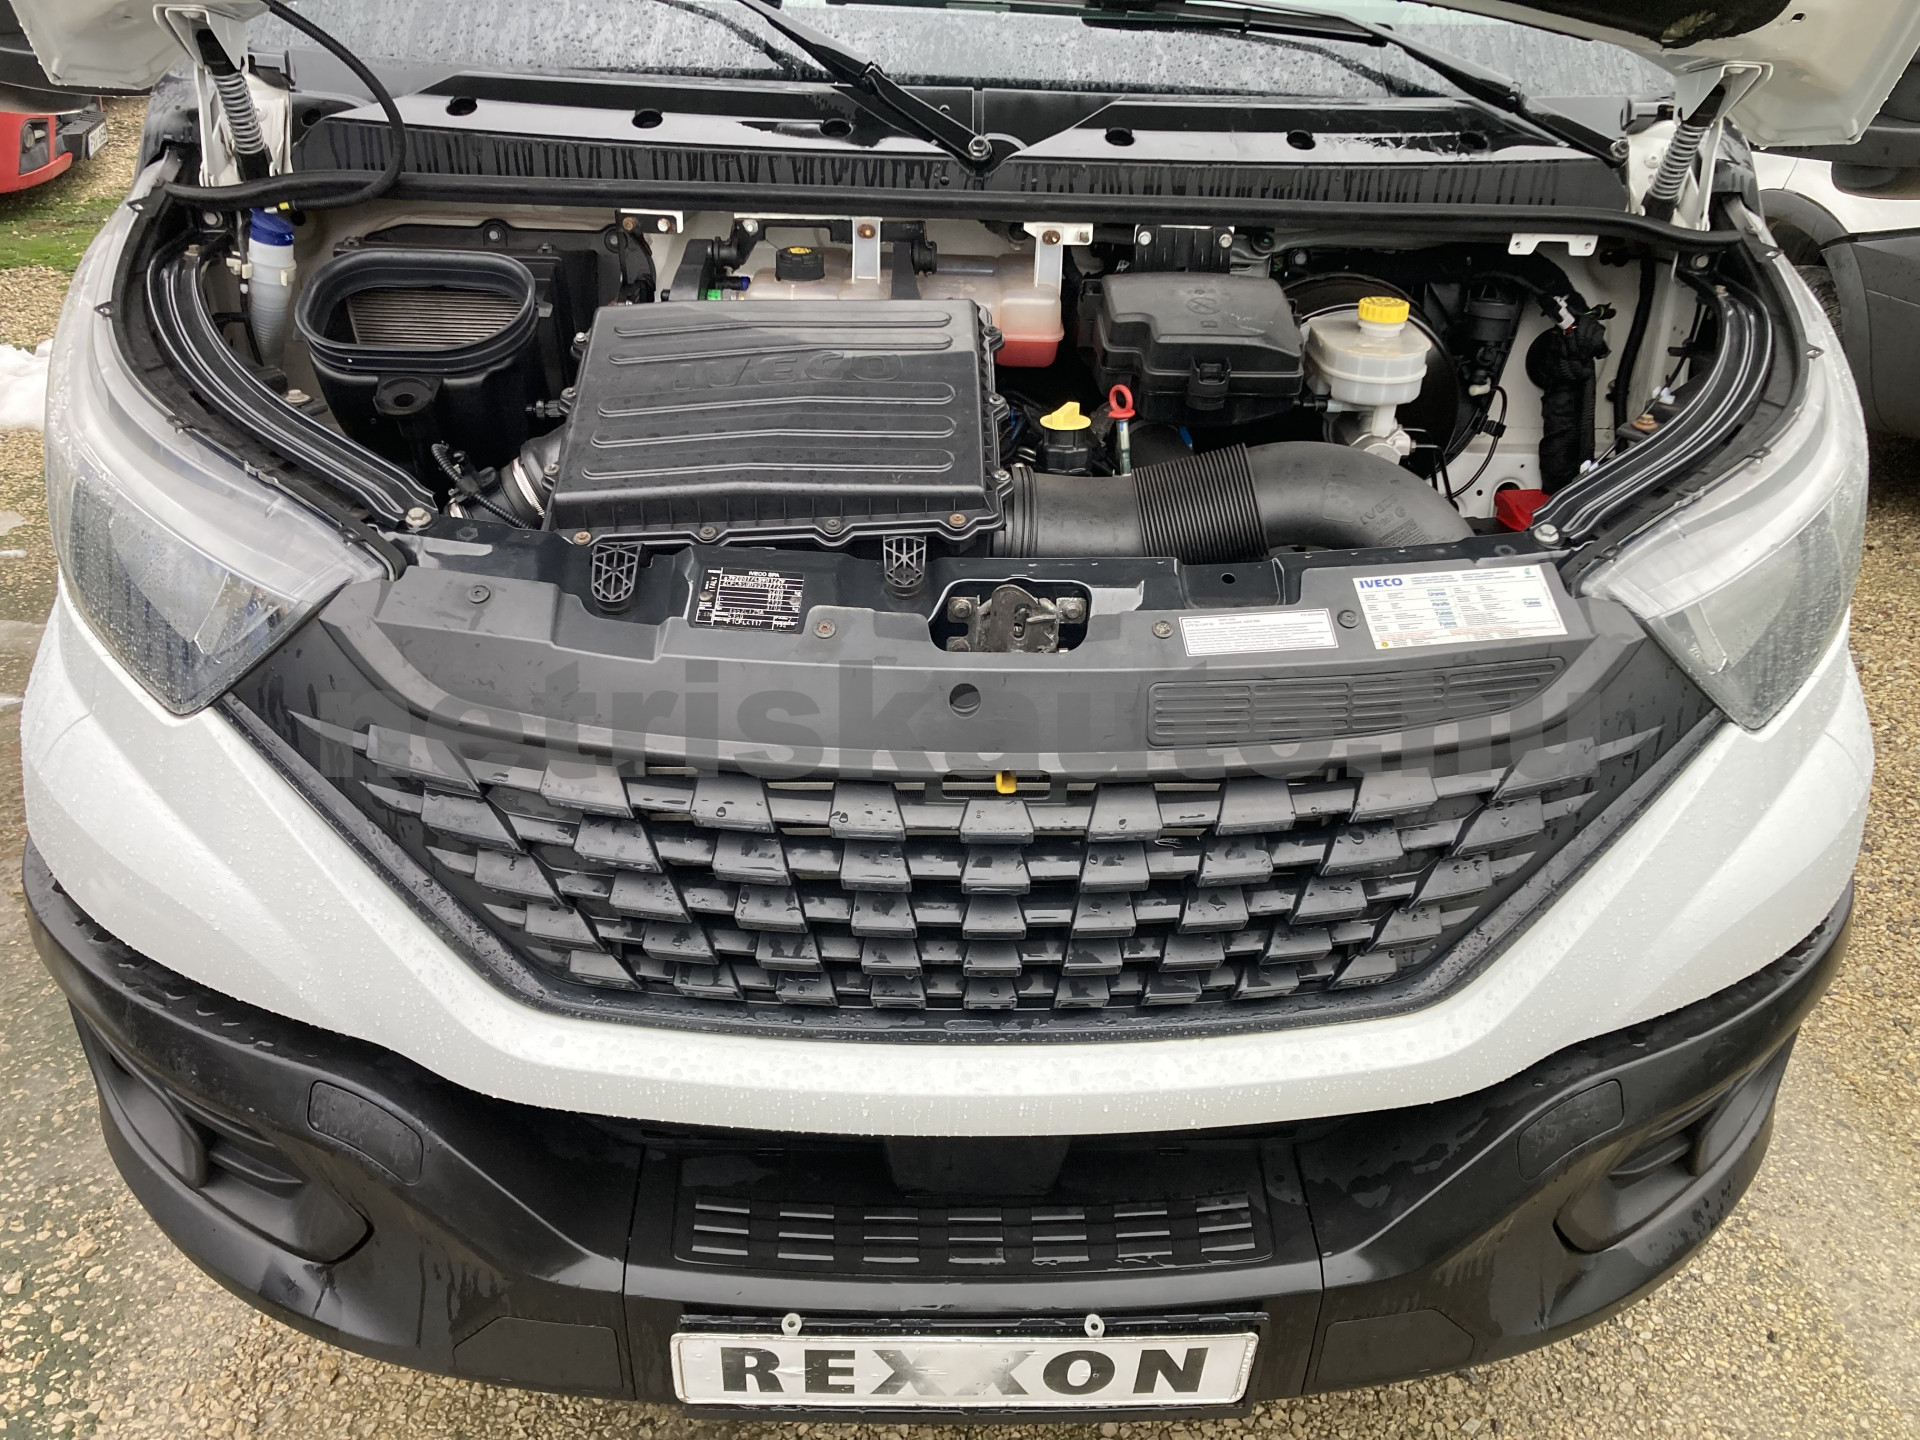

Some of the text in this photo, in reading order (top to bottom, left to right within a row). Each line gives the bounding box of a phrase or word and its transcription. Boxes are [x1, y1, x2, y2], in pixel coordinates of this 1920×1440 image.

[672, 351, 904, 391] IVECO
[1359, 577, 1403, 589] IVECO
[719, 1346, 1209, 1396] REXXON
